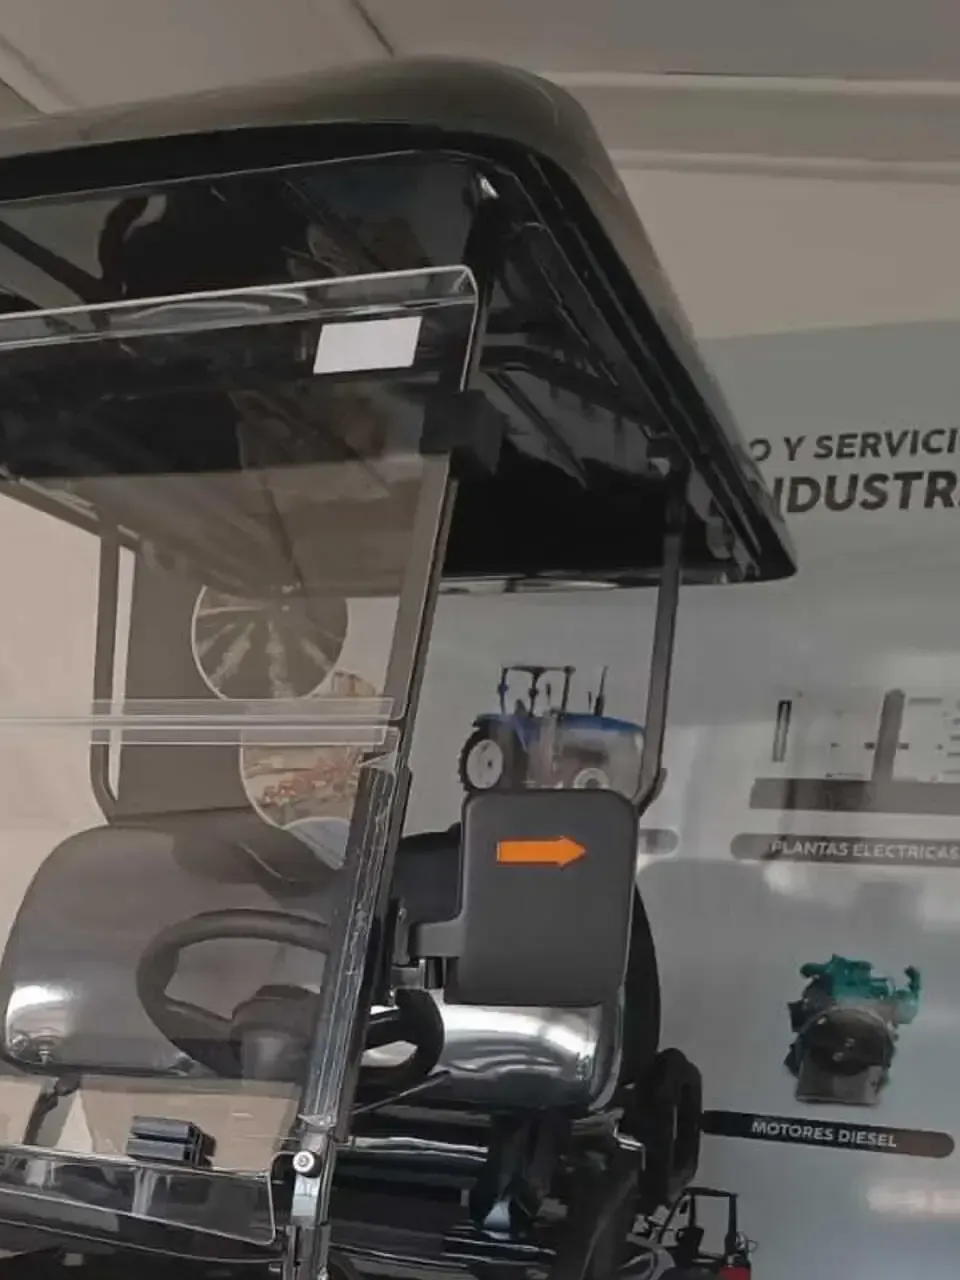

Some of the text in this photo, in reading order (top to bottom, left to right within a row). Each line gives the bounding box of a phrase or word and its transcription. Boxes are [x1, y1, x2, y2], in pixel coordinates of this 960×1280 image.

[784, 435, 807, 462] Y
[771, 839, 849, 858] PLANTAS
[751, 1119, 898, 1149] MOTORES DIESEL
